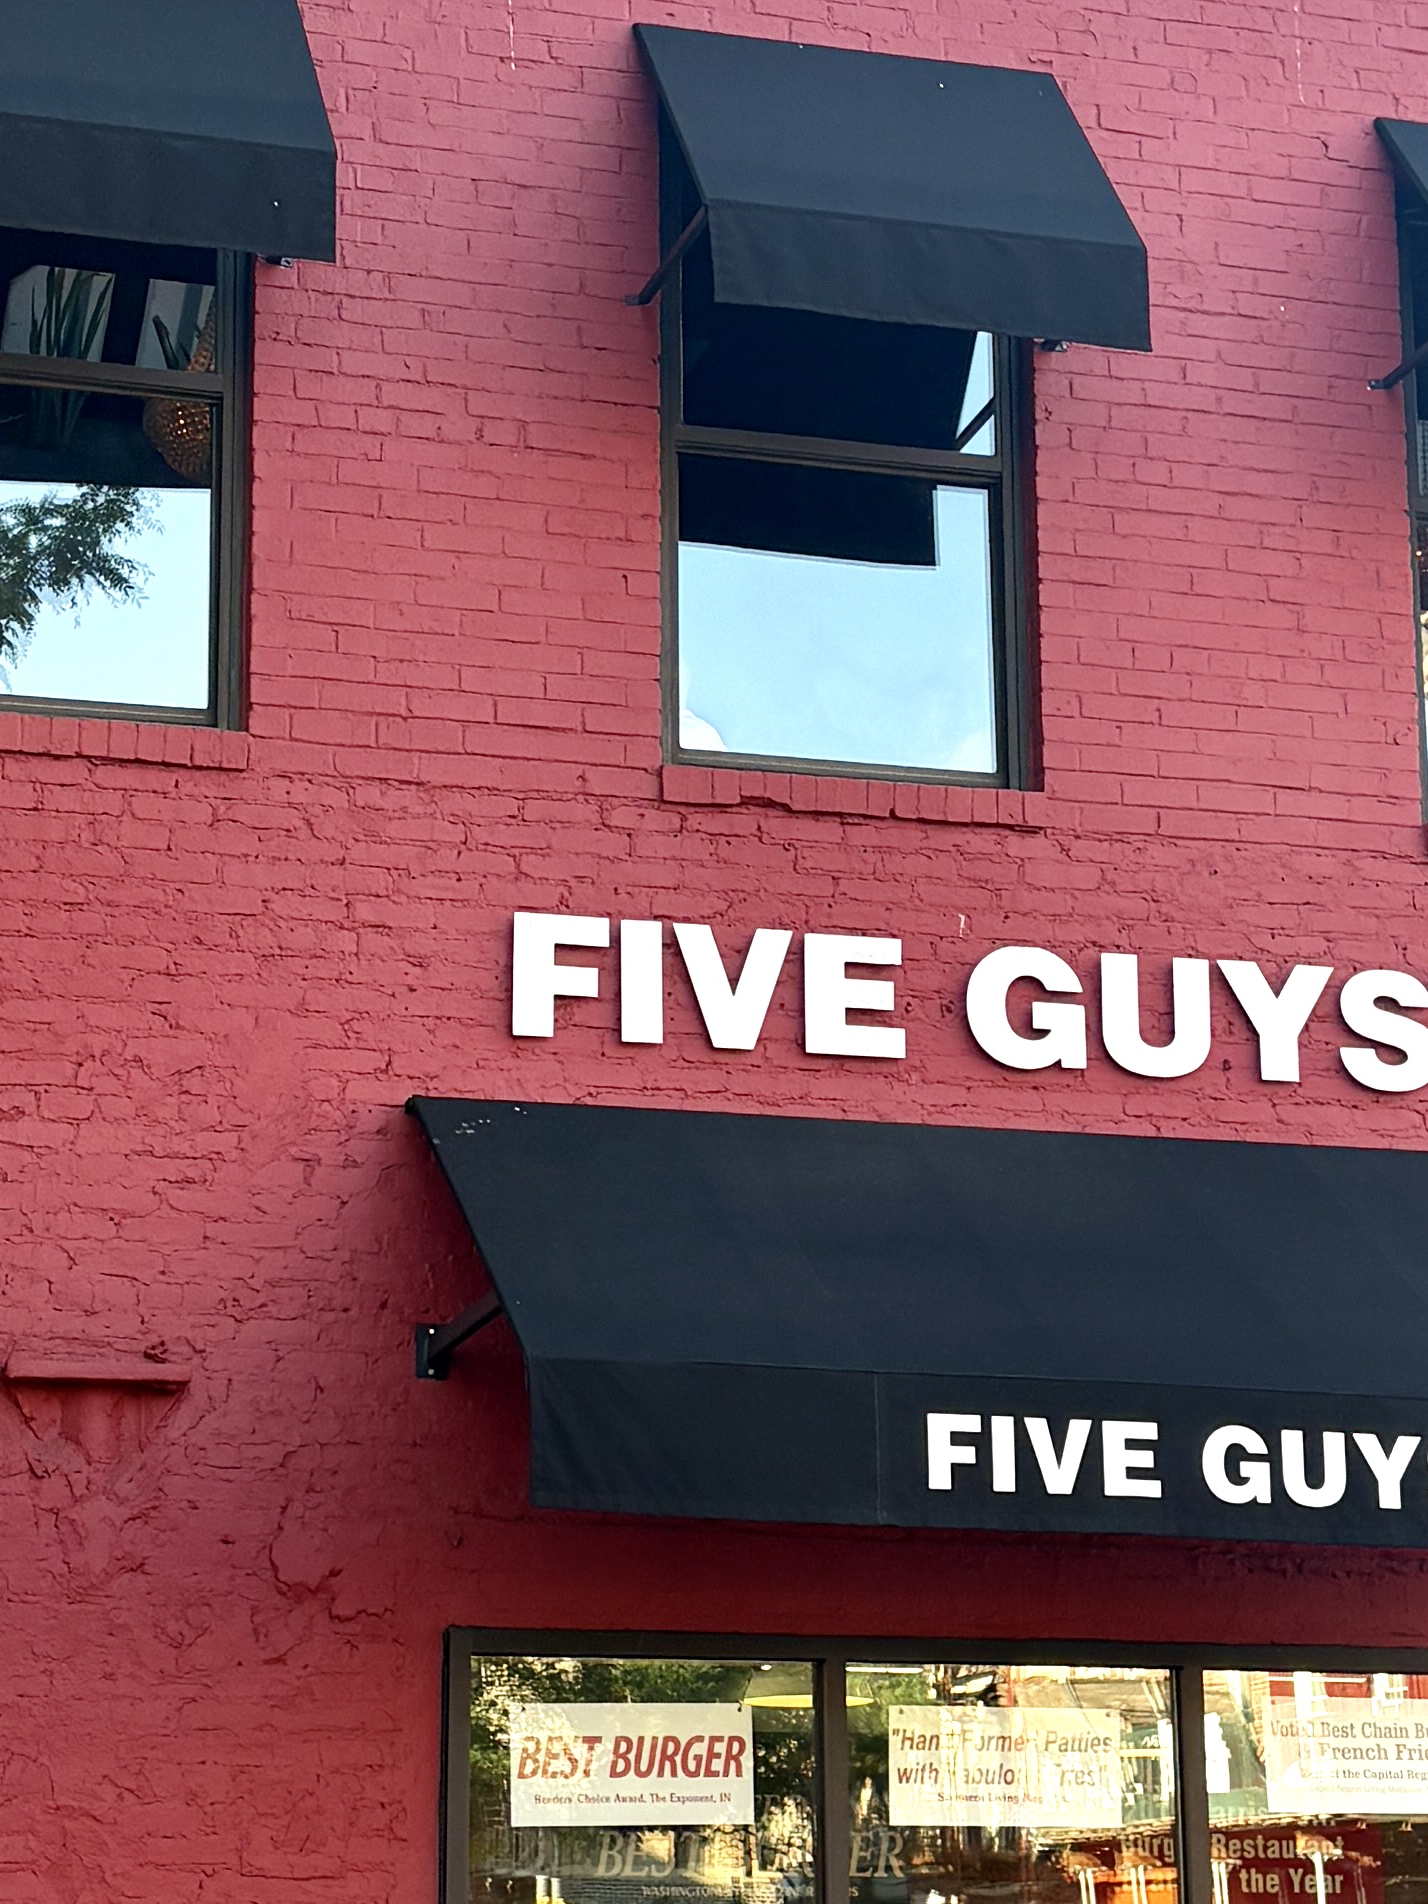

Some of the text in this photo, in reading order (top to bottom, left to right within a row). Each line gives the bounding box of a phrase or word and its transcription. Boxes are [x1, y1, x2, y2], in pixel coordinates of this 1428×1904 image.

[512, 910, 907, 1060] FIVE
[926, 1411, 1163, 1499] FIVE
[891, 1728, 1113, 1754] "Han Forme Patties
[1321, 1721, 1355, 1739] Best
[1361, 1721, 1409, 1740] Chain
[517, 1735, 747, 1780] BEST BURGER
[1318, 1743, 1389, 1762] French
[897, 1762, 940, 1786] with
[1363, 1769, 1405, 1781] Capital
[577, 1794, 611, 1805] Choice
[649, 1793, 667, 1804] The
[719, 1792, 732, 1803] IN
[1210, 1833, 1345, 1861] Restauant
[1239, 1868, 1280, 1894] the
